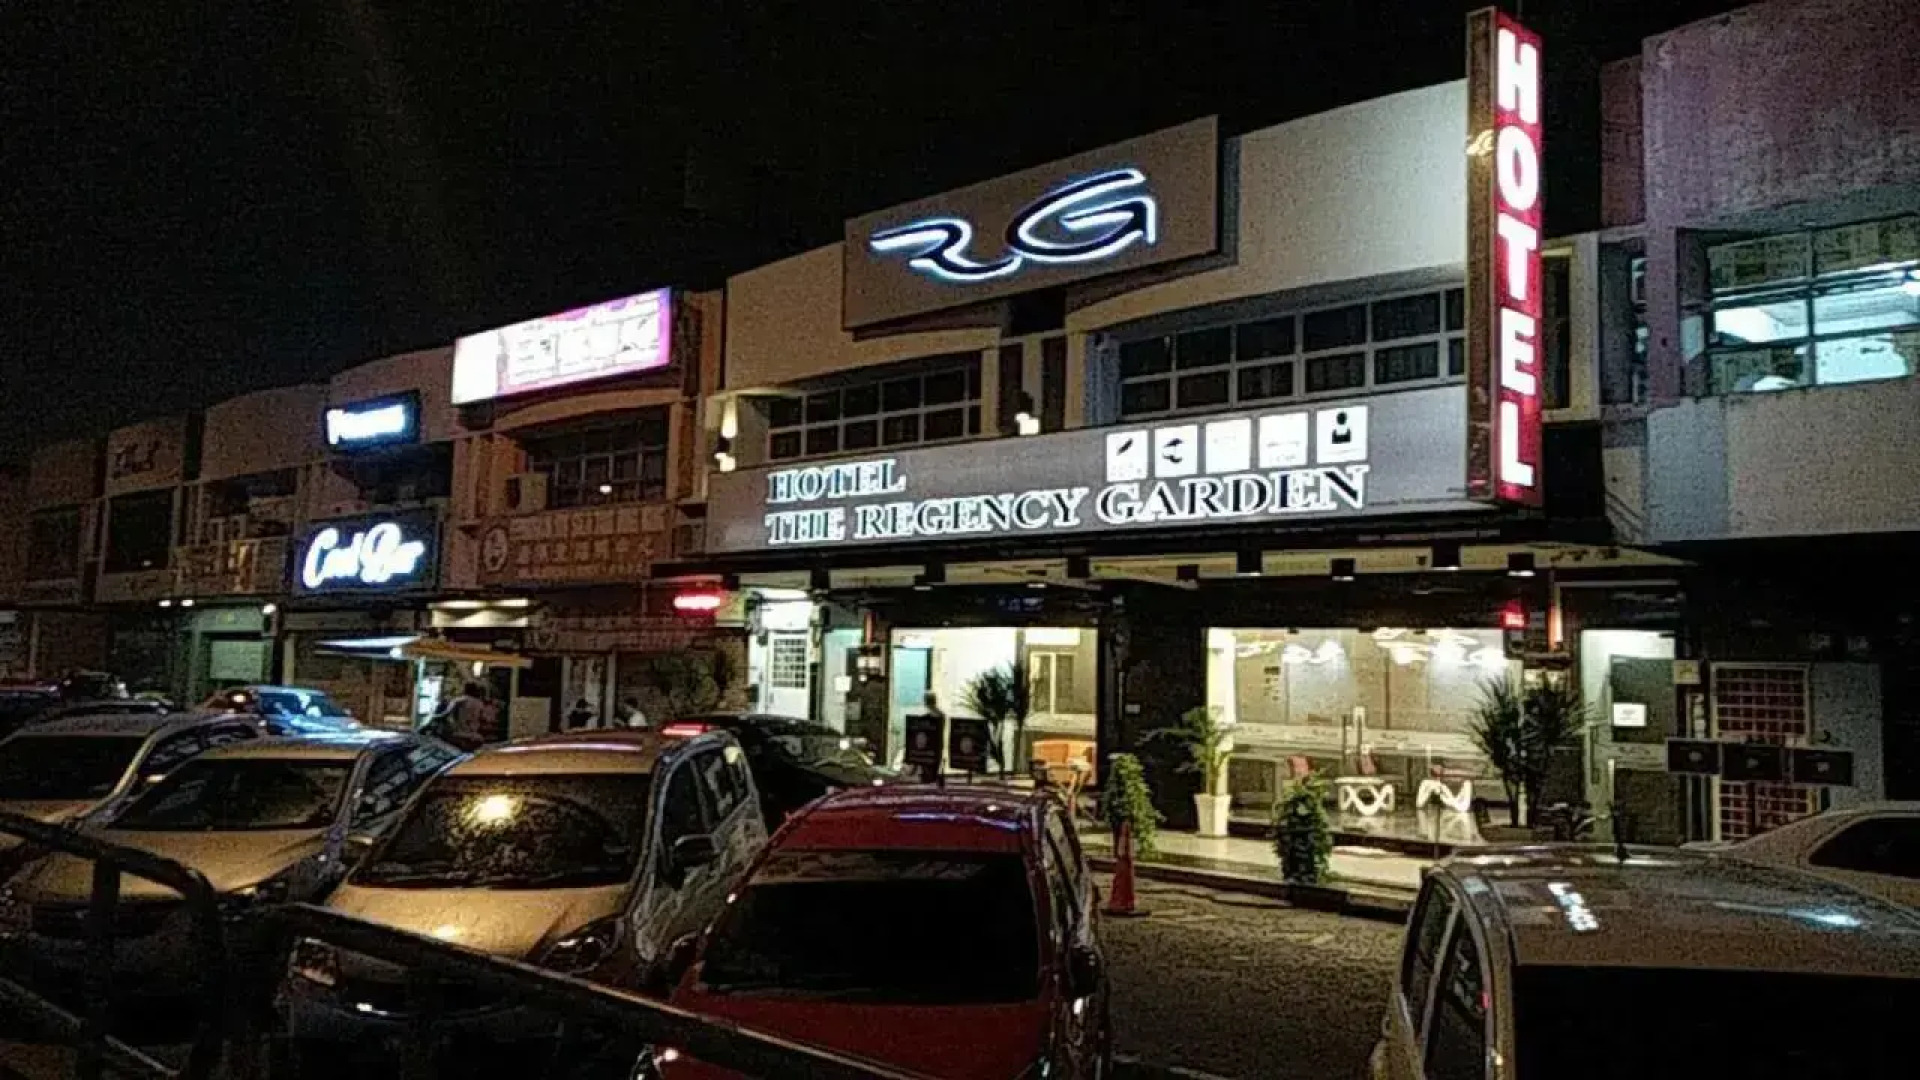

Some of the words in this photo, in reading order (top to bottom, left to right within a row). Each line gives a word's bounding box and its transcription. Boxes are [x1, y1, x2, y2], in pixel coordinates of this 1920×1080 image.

[1497, 27, 1540, 487] HOTEL
[765, 506, 846, 544] THE
[853, 486, 1090, 539] REGENCY
[1096, 464, 1370, 524] GARDEN
[766, 458, 907, 503] HOTEL
